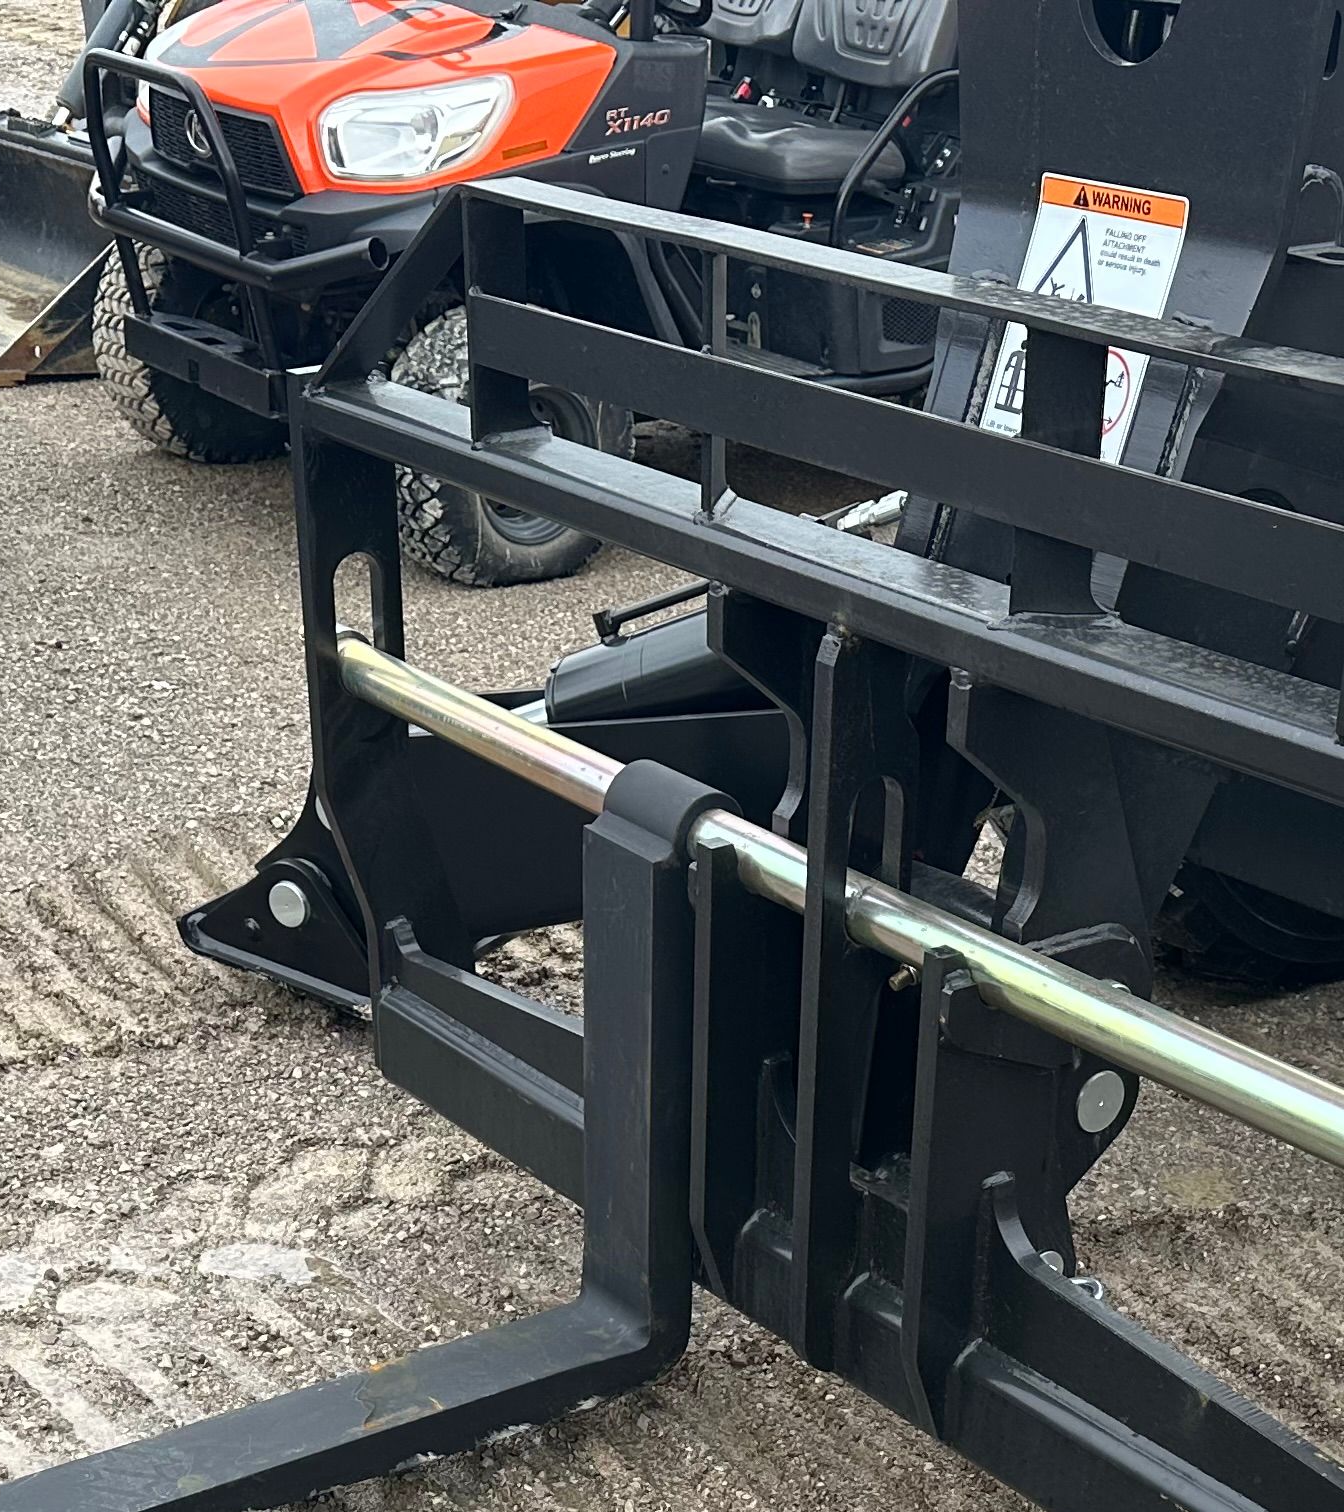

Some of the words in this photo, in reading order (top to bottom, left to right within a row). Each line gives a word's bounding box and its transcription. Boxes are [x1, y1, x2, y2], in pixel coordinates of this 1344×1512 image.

[606, 107, 629, 121] RT
[605, 109, 671, 136] X1140
[1093, 190, 1151, 215] WARNING
[1105, 228, 1132, 240] FALLING
[1103, 239, 1146, 253] ATTACHMENT
